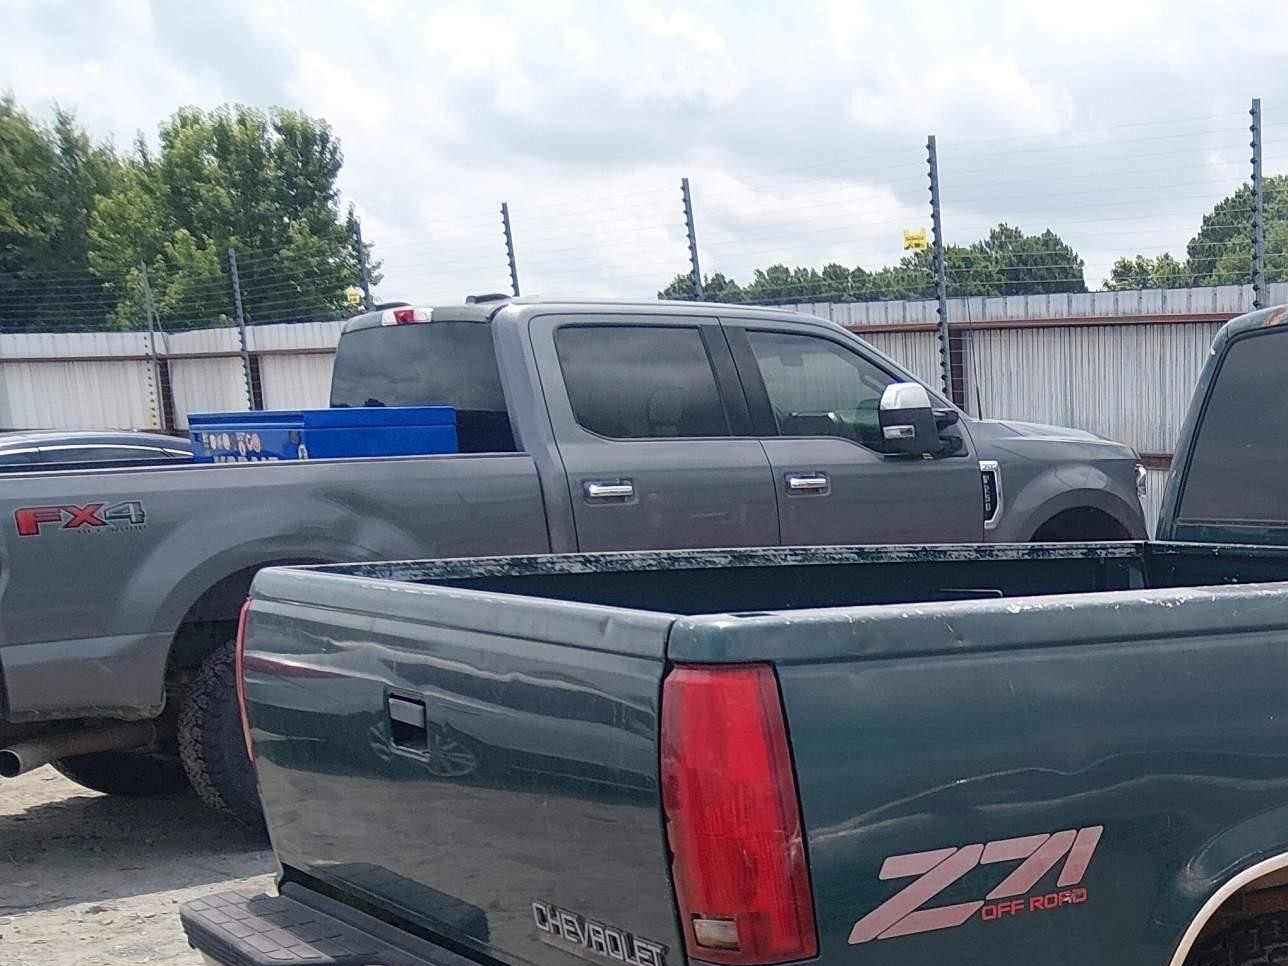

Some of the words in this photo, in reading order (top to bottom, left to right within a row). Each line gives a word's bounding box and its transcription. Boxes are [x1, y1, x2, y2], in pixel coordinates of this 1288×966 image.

[14, 500, 146, 536] FX4
[848, 824, 1104, 945] Z71
[981, 899, 1026, 922] OFF
[1029, 886, 1088, 912] ROAD
